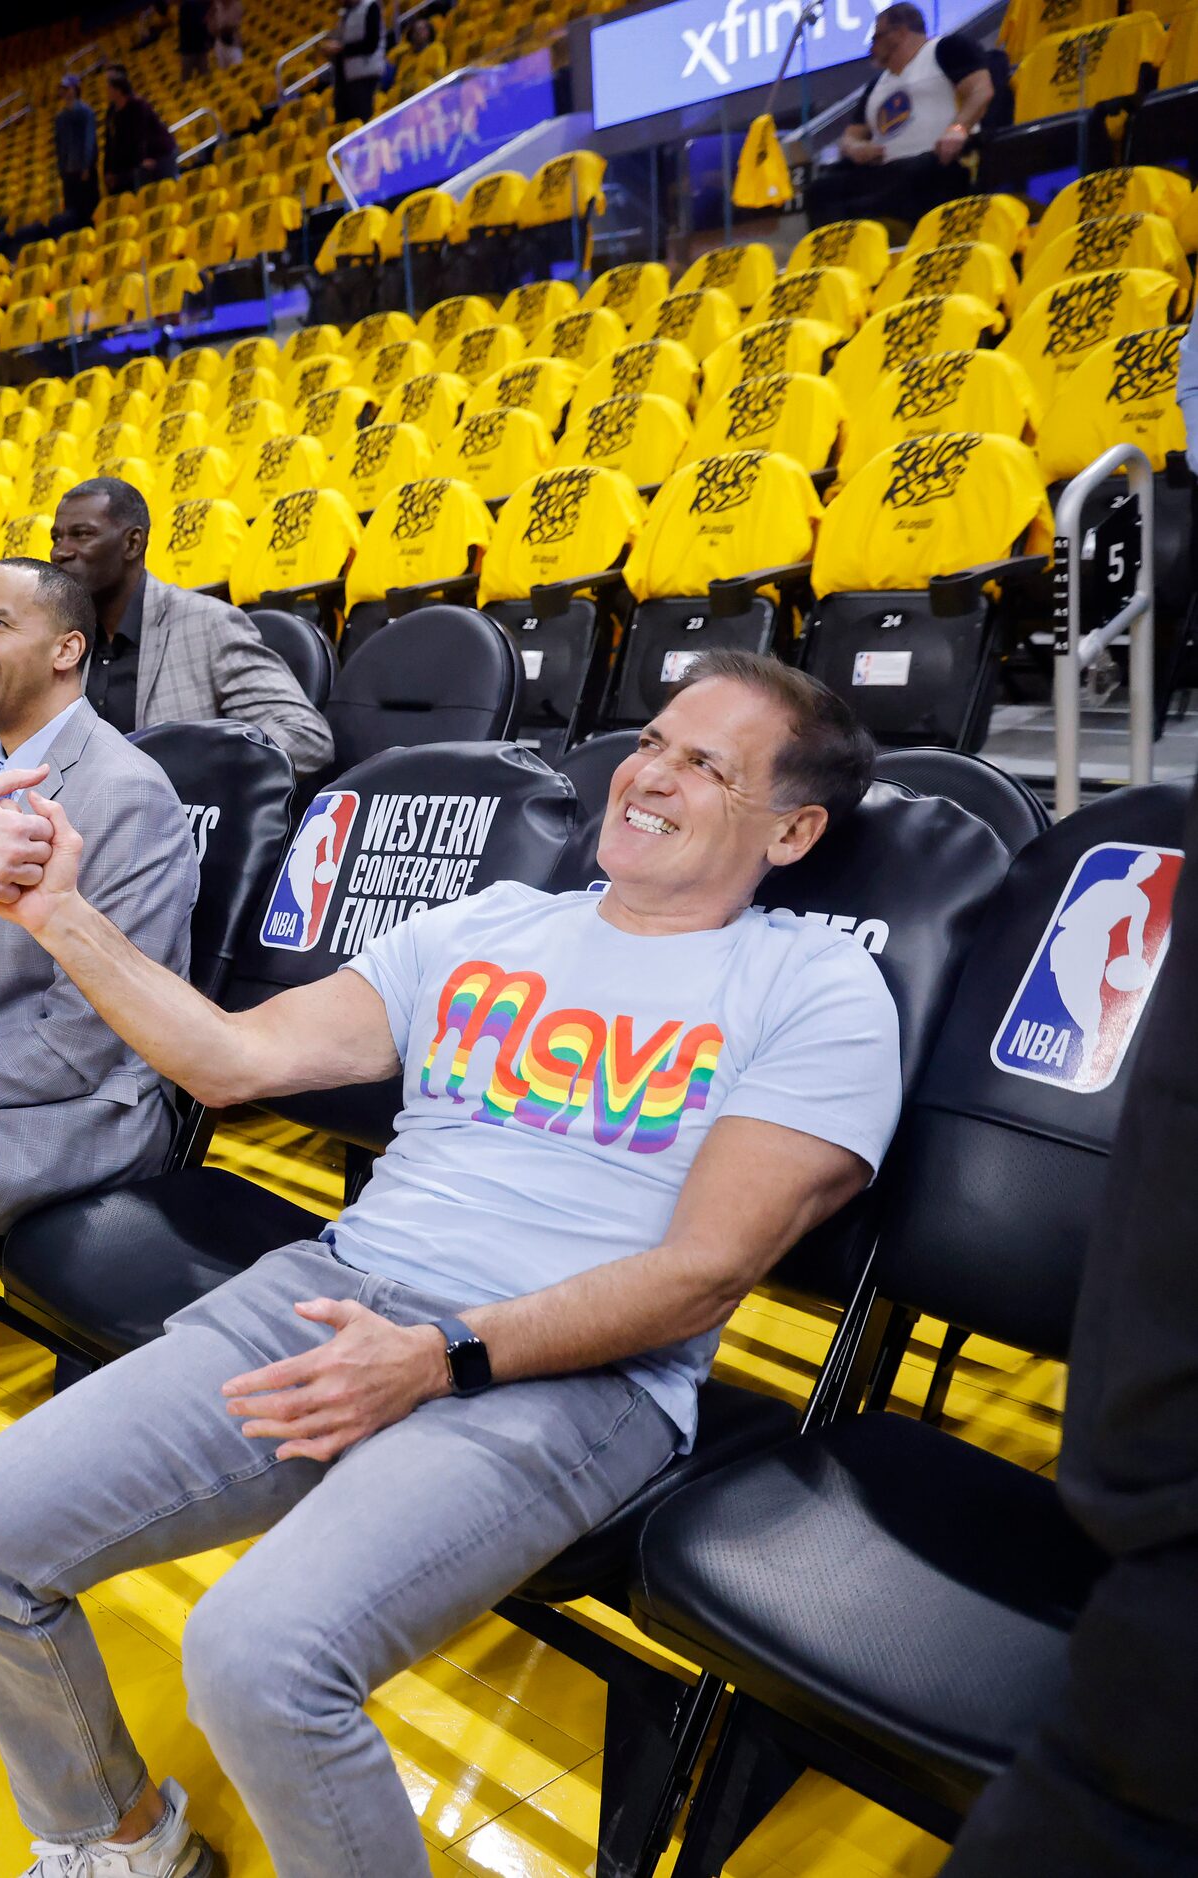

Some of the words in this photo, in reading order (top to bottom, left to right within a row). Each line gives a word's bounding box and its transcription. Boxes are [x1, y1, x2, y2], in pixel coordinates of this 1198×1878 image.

[1107, 541, 1125, 583] 5
[880, 613, 903, 628] 24
[360, 793, 501, 856] WESTERN
[347, 854, 480, 902] CONFERENCE
[267, 911, 299, 938] NBA
[1007, 1018, 1072, 1069] NBA
